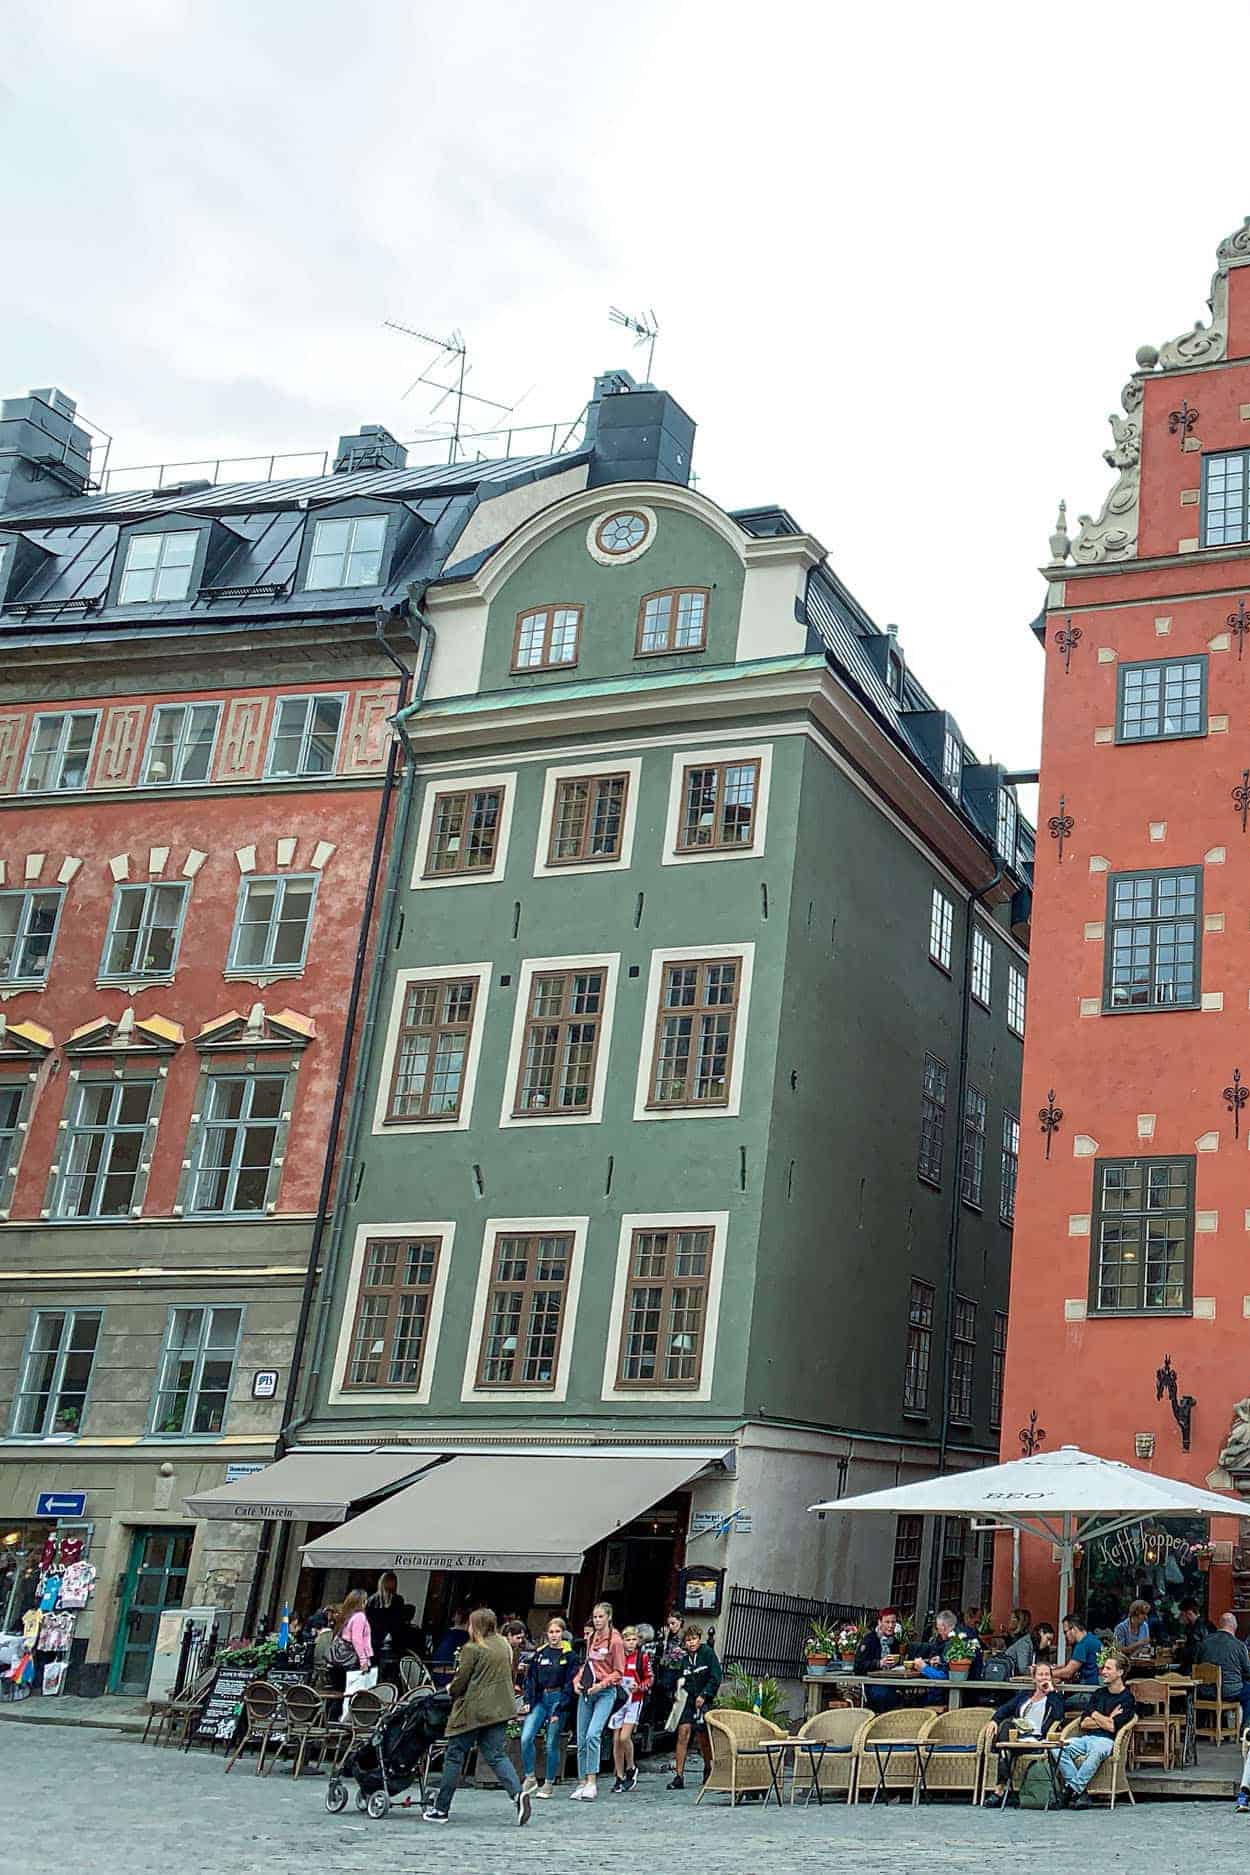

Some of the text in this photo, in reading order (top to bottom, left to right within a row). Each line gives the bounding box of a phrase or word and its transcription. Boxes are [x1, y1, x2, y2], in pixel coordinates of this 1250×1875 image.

[1099, 1519, 1190, 1568] Kaffekoppen
[394, 1554, 487, 1568] Restaurang & Bar
